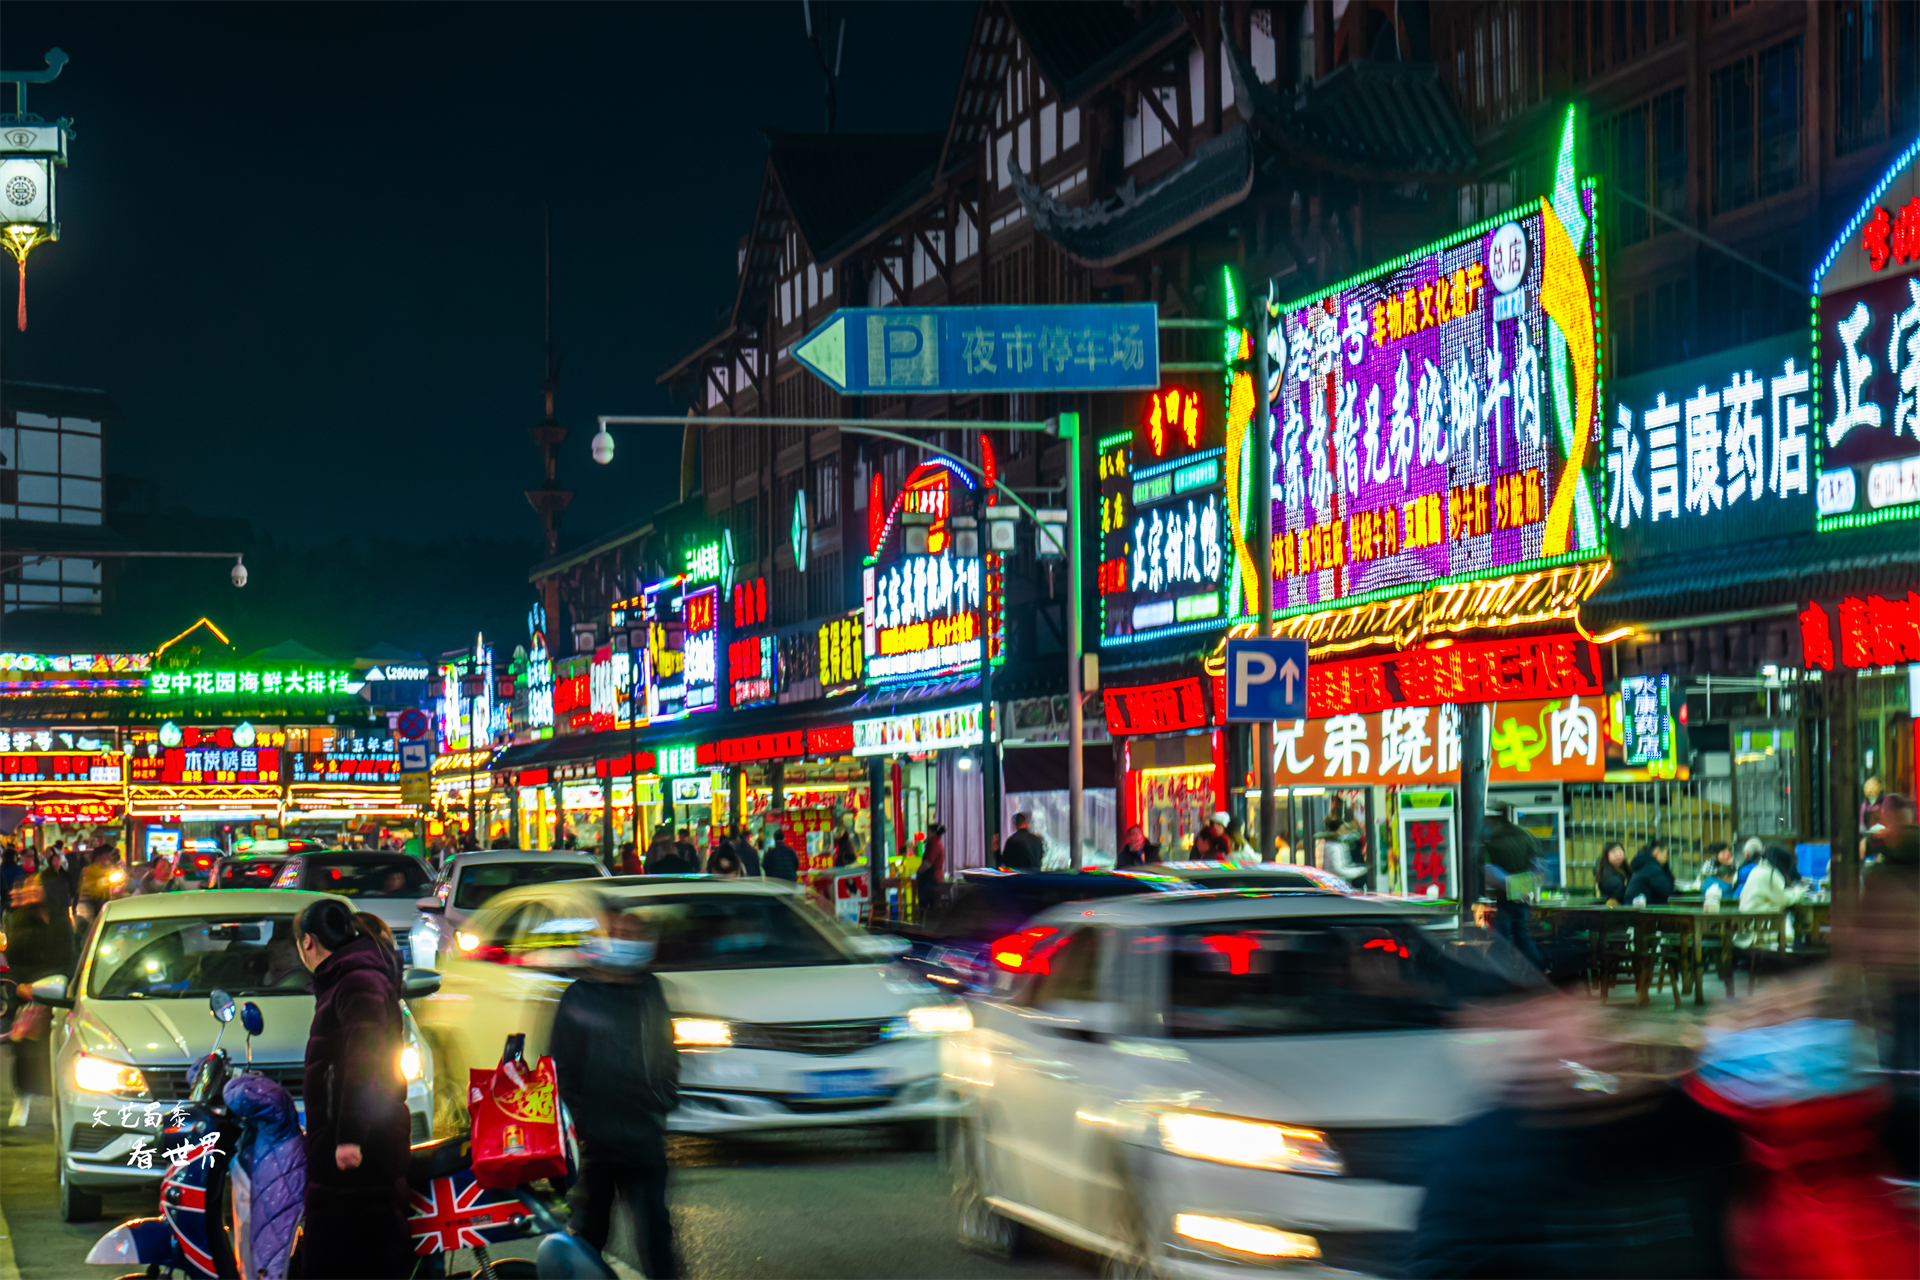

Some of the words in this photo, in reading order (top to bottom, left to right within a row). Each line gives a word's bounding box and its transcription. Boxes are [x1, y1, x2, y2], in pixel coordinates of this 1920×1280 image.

[1492, 237, 1522, 280] 总店
[1372, 261, 1484, 347] 非物质文化遗产
[883, 324, 924, 380] P
[961, 322, 1145, 375] 夜市停车场
[1290, 301, 1368, 381] 老字号
[1607, 358, 1809, 529] 永言康药店
[152, 671, 350, 694] 空中花园海鲜大排档
[1235, 650, 1277, 707] P
[185, 749, 258, 772] 木炭烤鱼
